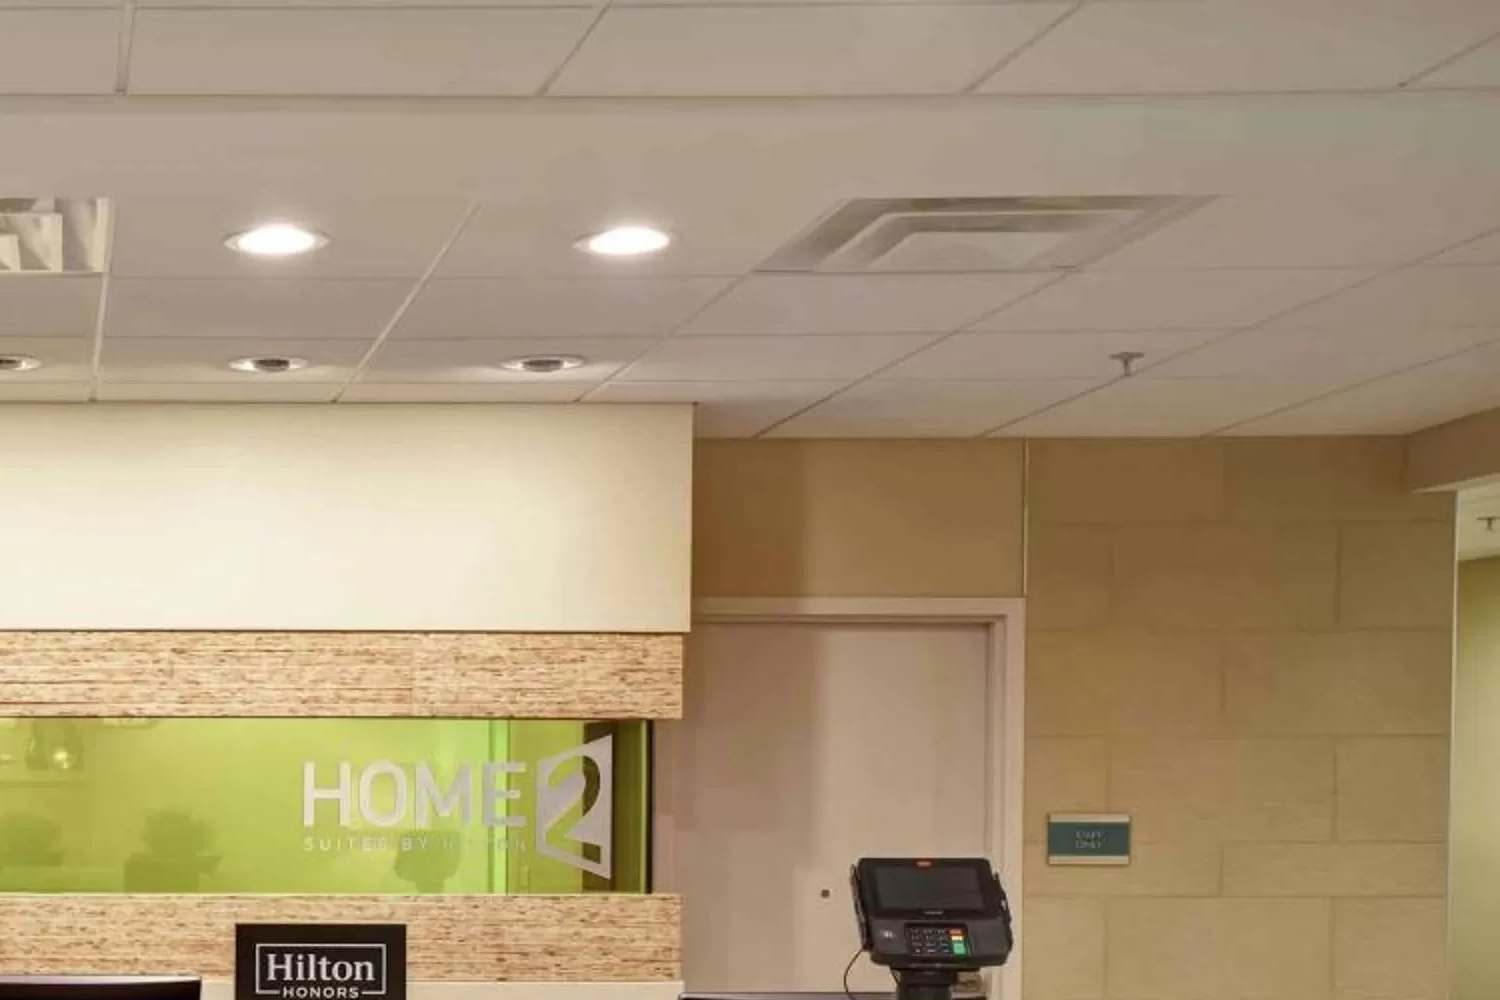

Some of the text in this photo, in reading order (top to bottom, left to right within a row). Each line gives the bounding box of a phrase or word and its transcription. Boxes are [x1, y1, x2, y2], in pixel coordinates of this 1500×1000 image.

[303, 760, 527, 828] HOME
[266, 953, 375, 981] Hilton
[283, 987, 359, 999] HONORS
